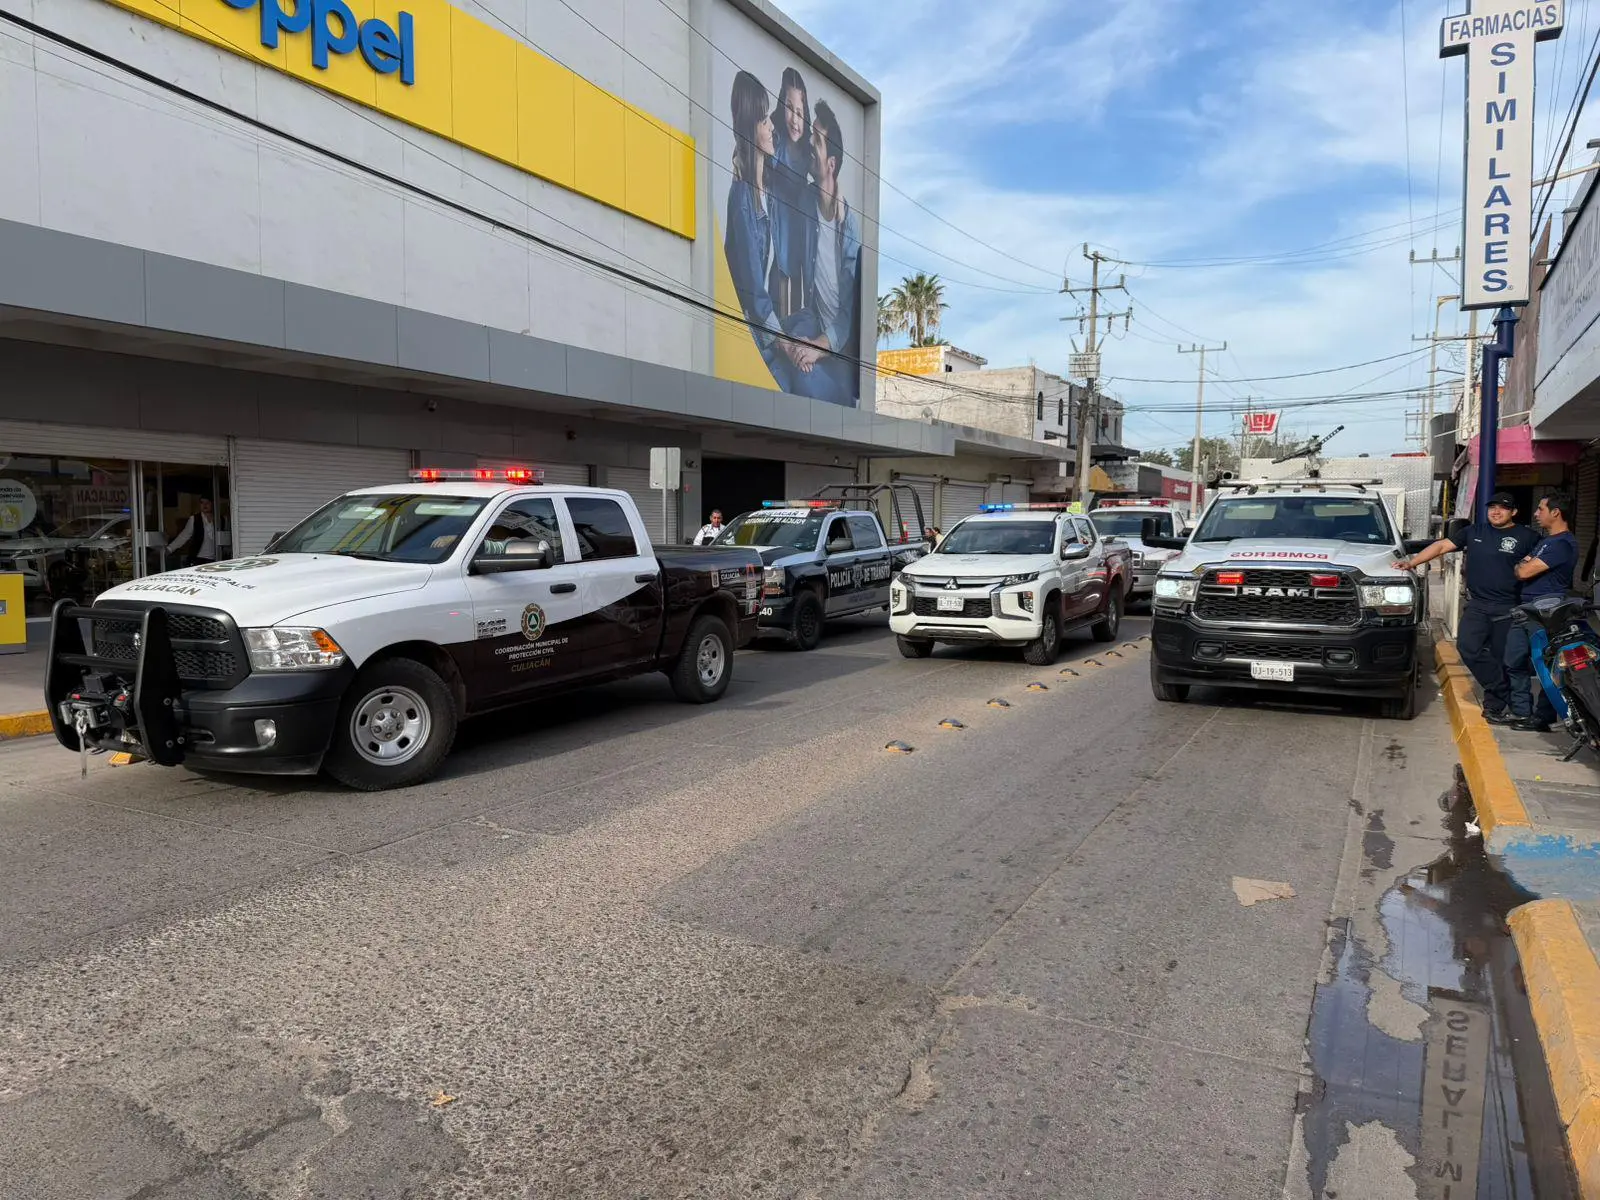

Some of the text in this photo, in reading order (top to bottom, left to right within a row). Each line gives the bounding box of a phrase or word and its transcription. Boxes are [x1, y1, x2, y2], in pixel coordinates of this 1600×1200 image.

[1450, 4, 1557, 41] FARMACIAS
[217, 0, 414, 86] ppel
[1482, 42, 1517, 293] SIMILARES
[1242, 587, 1310, 597] RAM
[759, 607, 773, 616] 40
[494, 642, 534, 655] COORDINACIÓN
[535, 639, 562, 648] MUNICIPAL
[508, 647, 555, 661] PROTECCIÓN CIVIL
[511, 658, 551, 673] CULIACÁN
[1252, 666, 1292, 677] UJ-19-513
